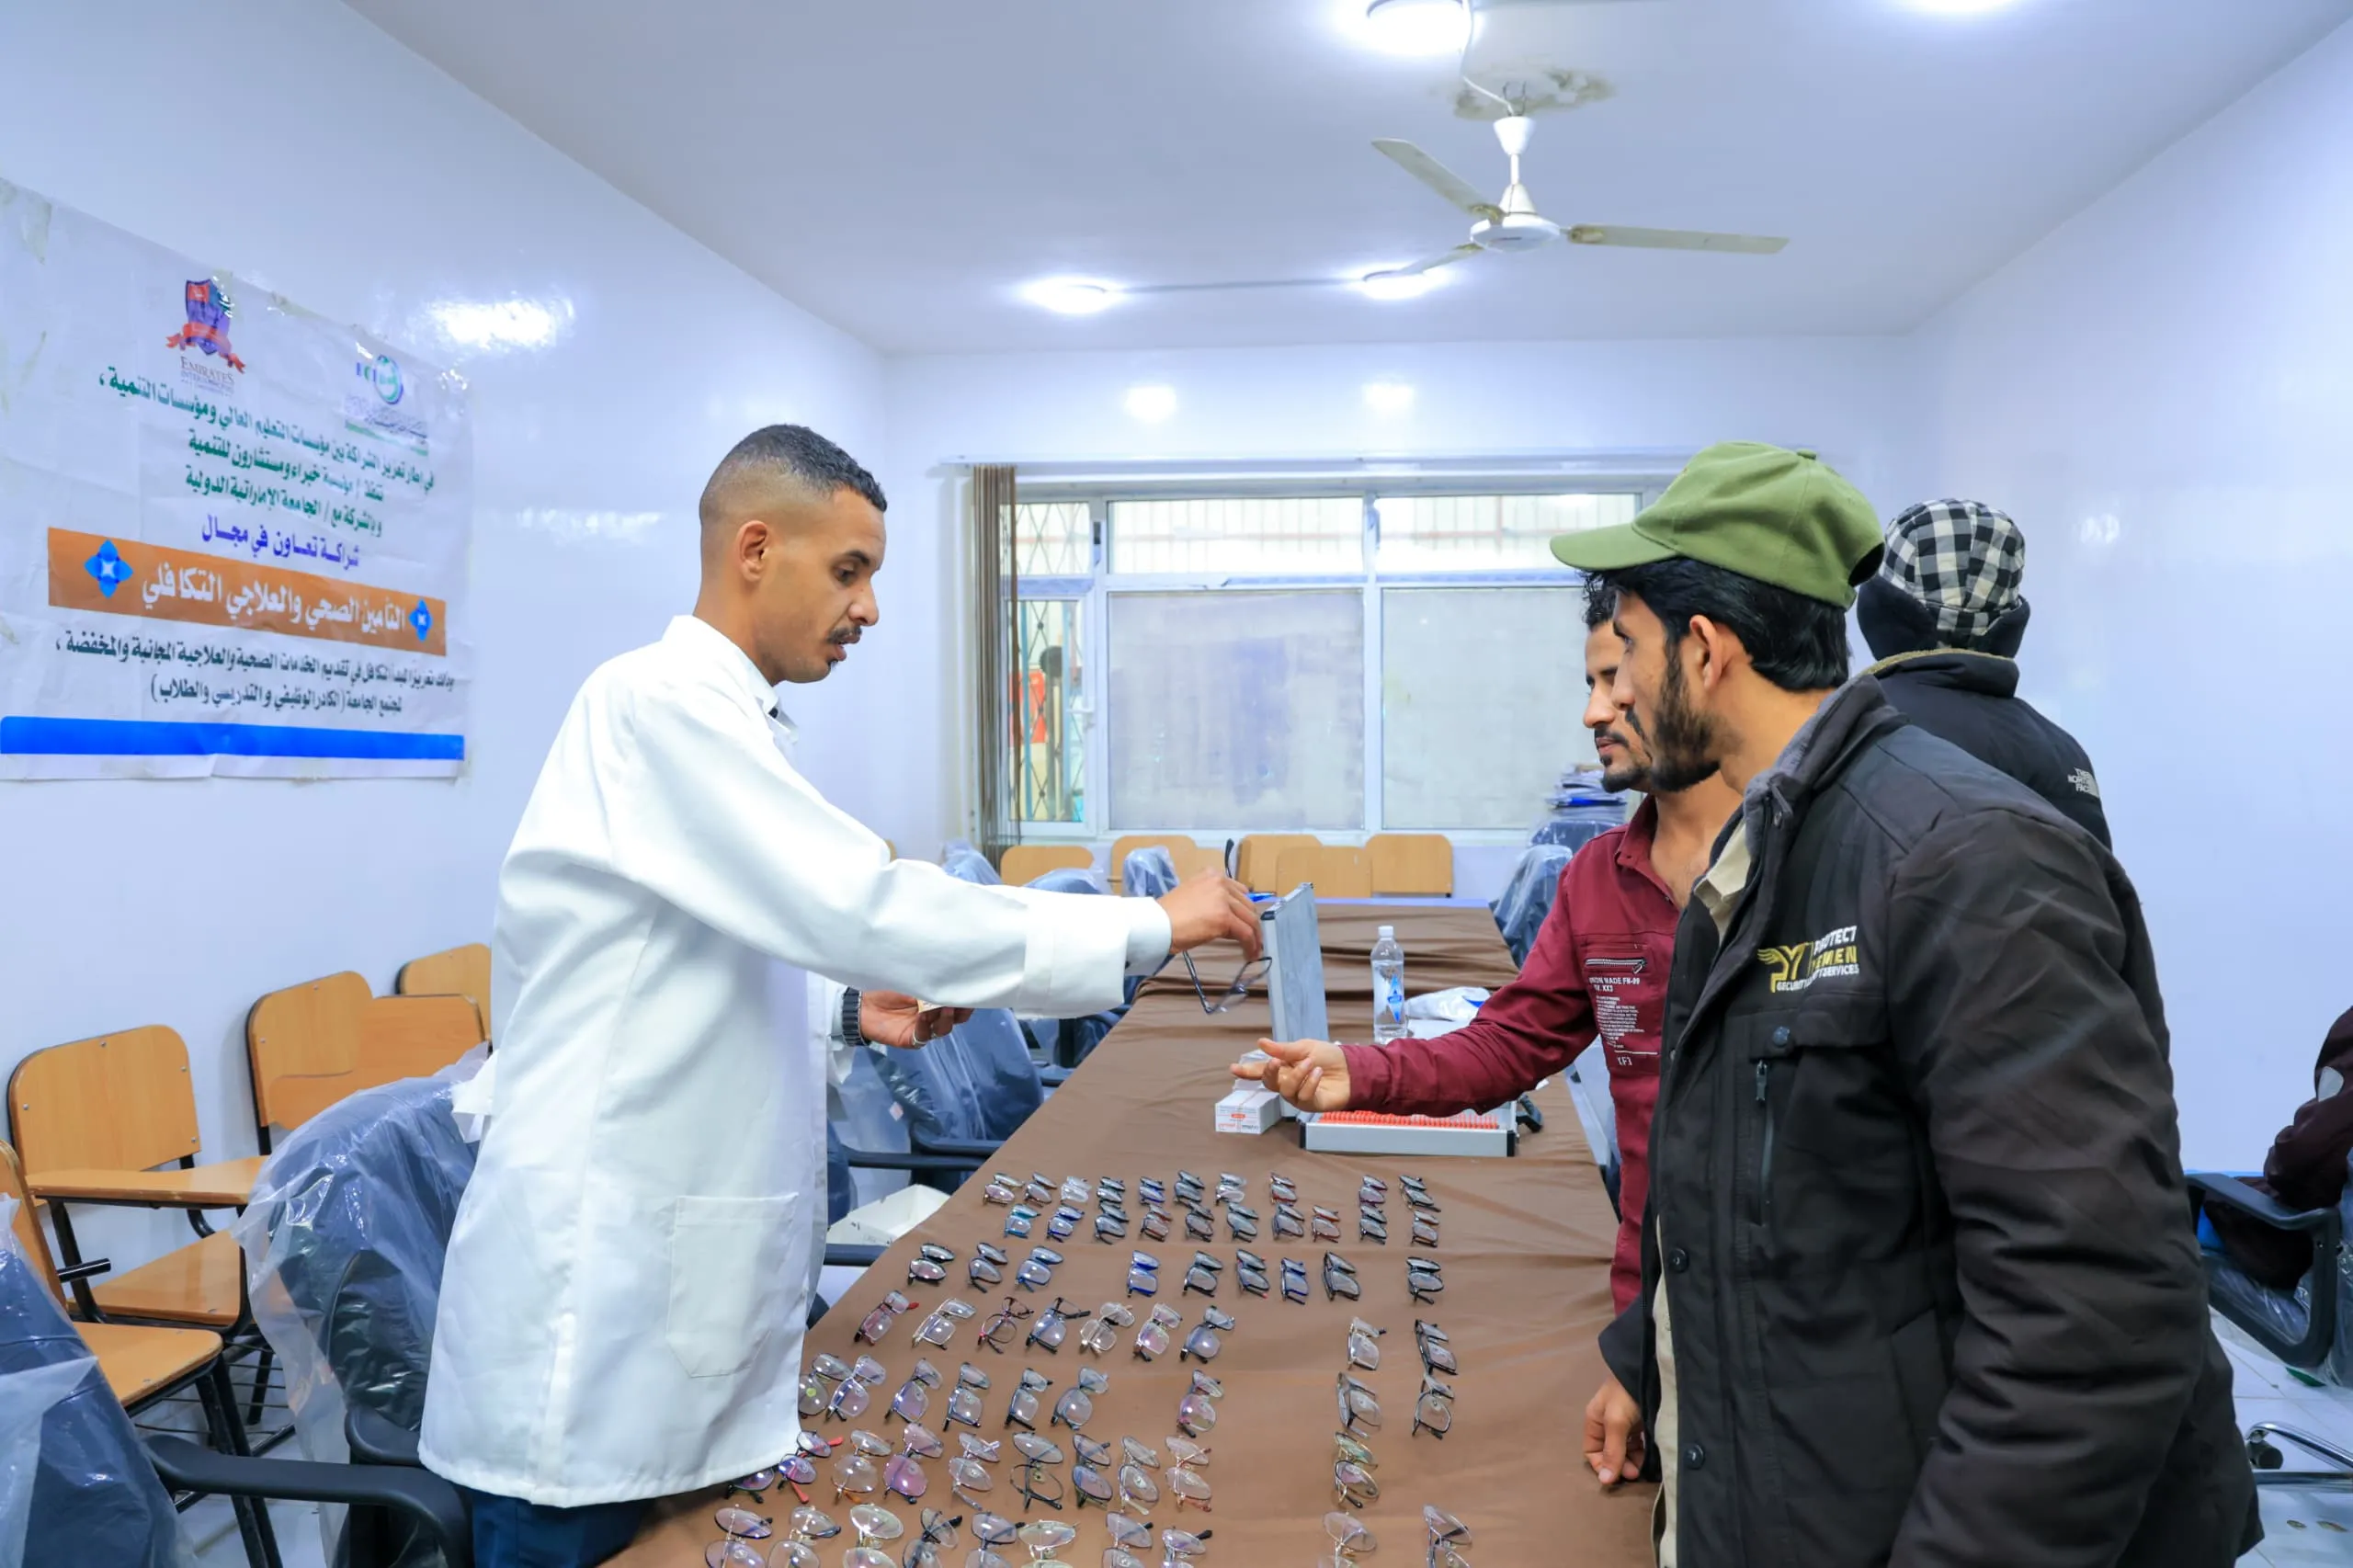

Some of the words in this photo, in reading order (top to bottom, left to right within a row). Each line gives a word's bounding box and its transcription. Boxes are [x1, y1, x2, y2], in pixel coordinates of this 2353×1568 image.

[220, 405, 253, 430] العالي
[256, 417, 290, 439] التعليم
[186, 464, 230, 495] الدولية
[251, 524, 269, 558] في
[142, 562, 223, 610] التكافلي
[226, 580, 302, 623] والعلاجي
[305, 595, 360, 631] الصحي
[131, 636, 176, 665] المجانية
[177, 641, 236, 671] والعلاجية
[236, 647, 278, 672] الصحية
